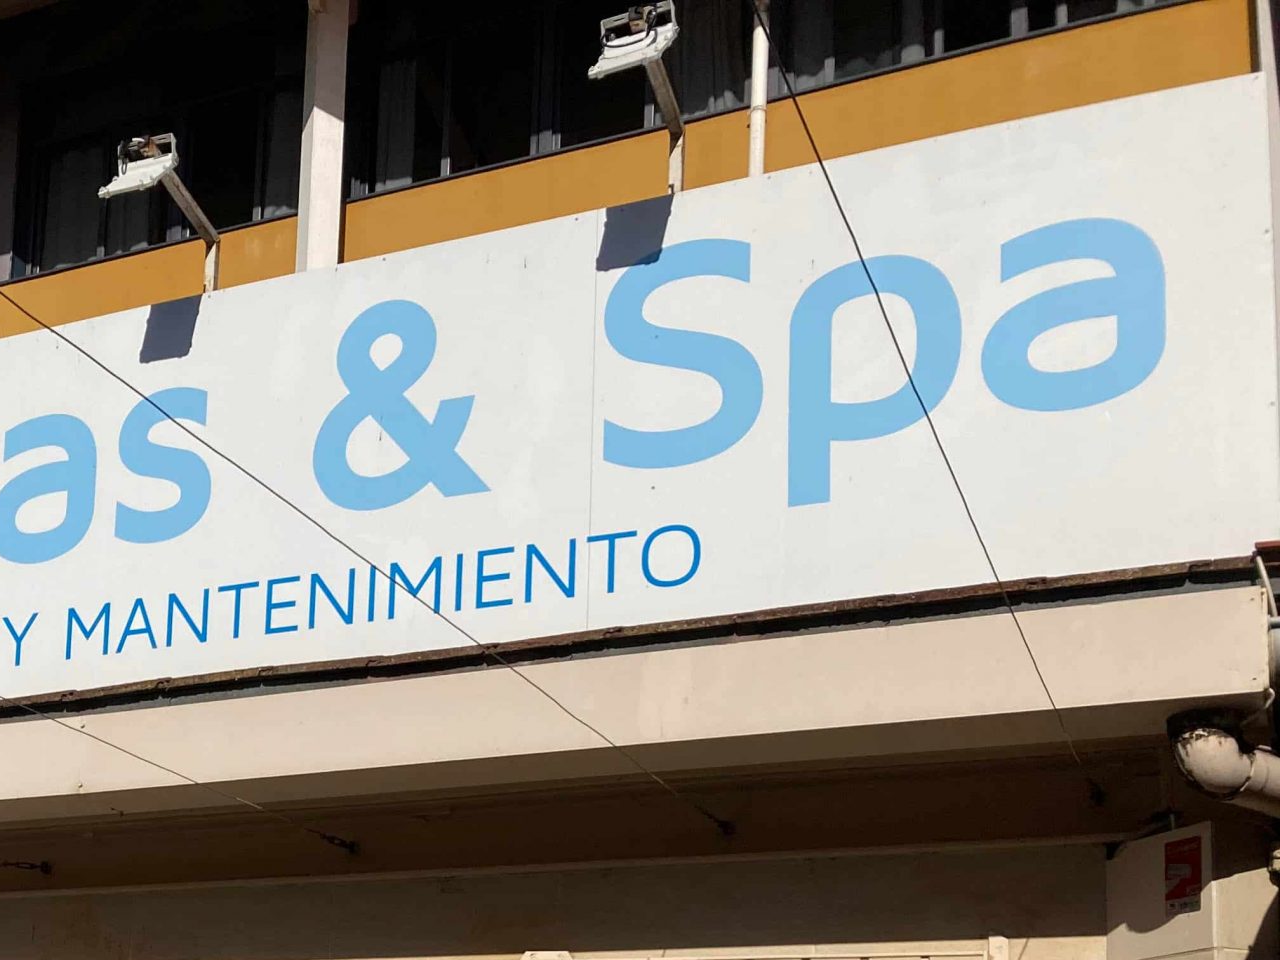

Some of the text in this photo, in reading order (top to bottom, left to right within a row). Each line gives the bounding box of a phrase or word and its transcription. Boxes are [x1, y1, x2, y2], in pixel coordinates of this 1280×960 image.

[312, 299, 492, 511] &
[602, 217, 1167, 508] Spa
[1, 611, 39, 667] Y
[64, 523, 702, 662] MANTENIMIENTO
